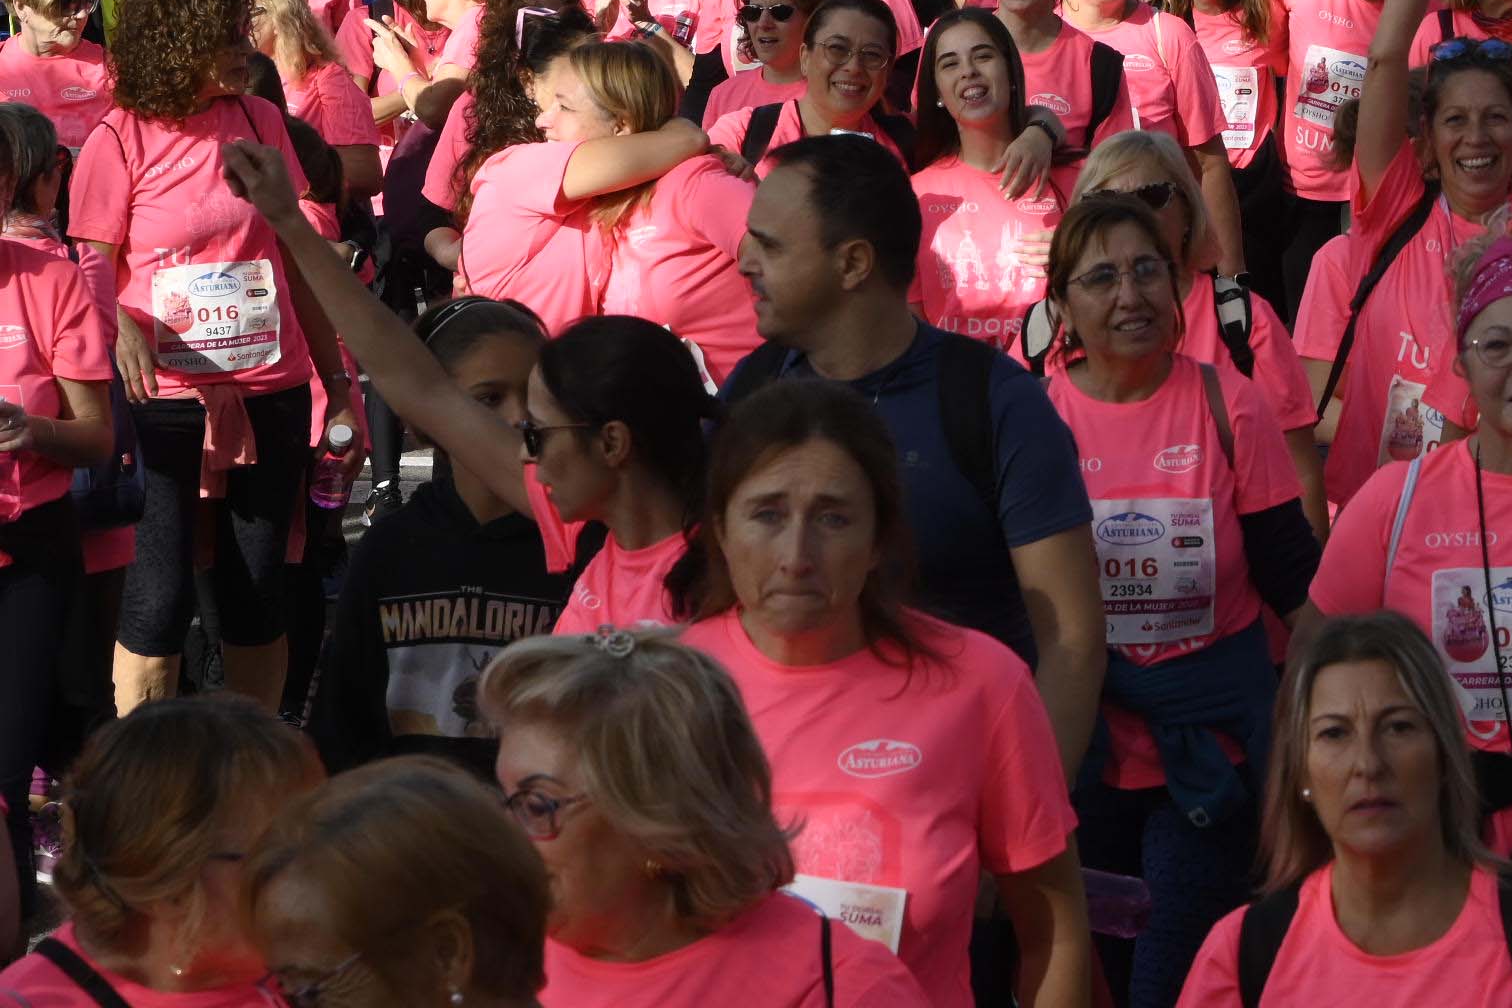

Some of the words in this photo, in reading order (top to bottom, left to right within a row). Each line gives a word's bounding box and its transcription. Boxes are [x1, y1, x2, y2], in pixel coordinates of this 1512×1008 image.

[1318, 10, 1353, 29] OYSHO
[1331, 82, 1360, 98] 016
[1302, 107, 1328, 121] OYSHO
[1296, 126, 1334, 151] SUM
[928, 202, 979, 213] OYSHO
[154, 247, 191, 266] TU
[193, 282, 237, 292] ASTURIANA
[198, 305, 239, 322] 016
[206, 326, 231, 336] 9437
[202, 340, 216, 349] DE
[218, 339, 228, 347] LA
[229, 337, 250, 346] MUJER
[1398, 331, 1430, 369] TU
[168, 357, 207, 367] OYSHO
[1171, 518, 1200, 526] SUMA
[1103, 526, 1160, 537] ASTURIANA
[1425, 531, 1498, 548] OYSHO
[1105, 558, 1158, 577] 016
[461, 585, 483, 593] THE
[1111, 584, 1153, 596] 23934
[1115, 603, 1128, 611] DE
[379, 598, 560, 642] MANDALORIA
[1457, 676, 1501, 685] CARRERA
[846, 753, 915, 769] ASTURIANA
[840, 911, 883, 926] SUMA
